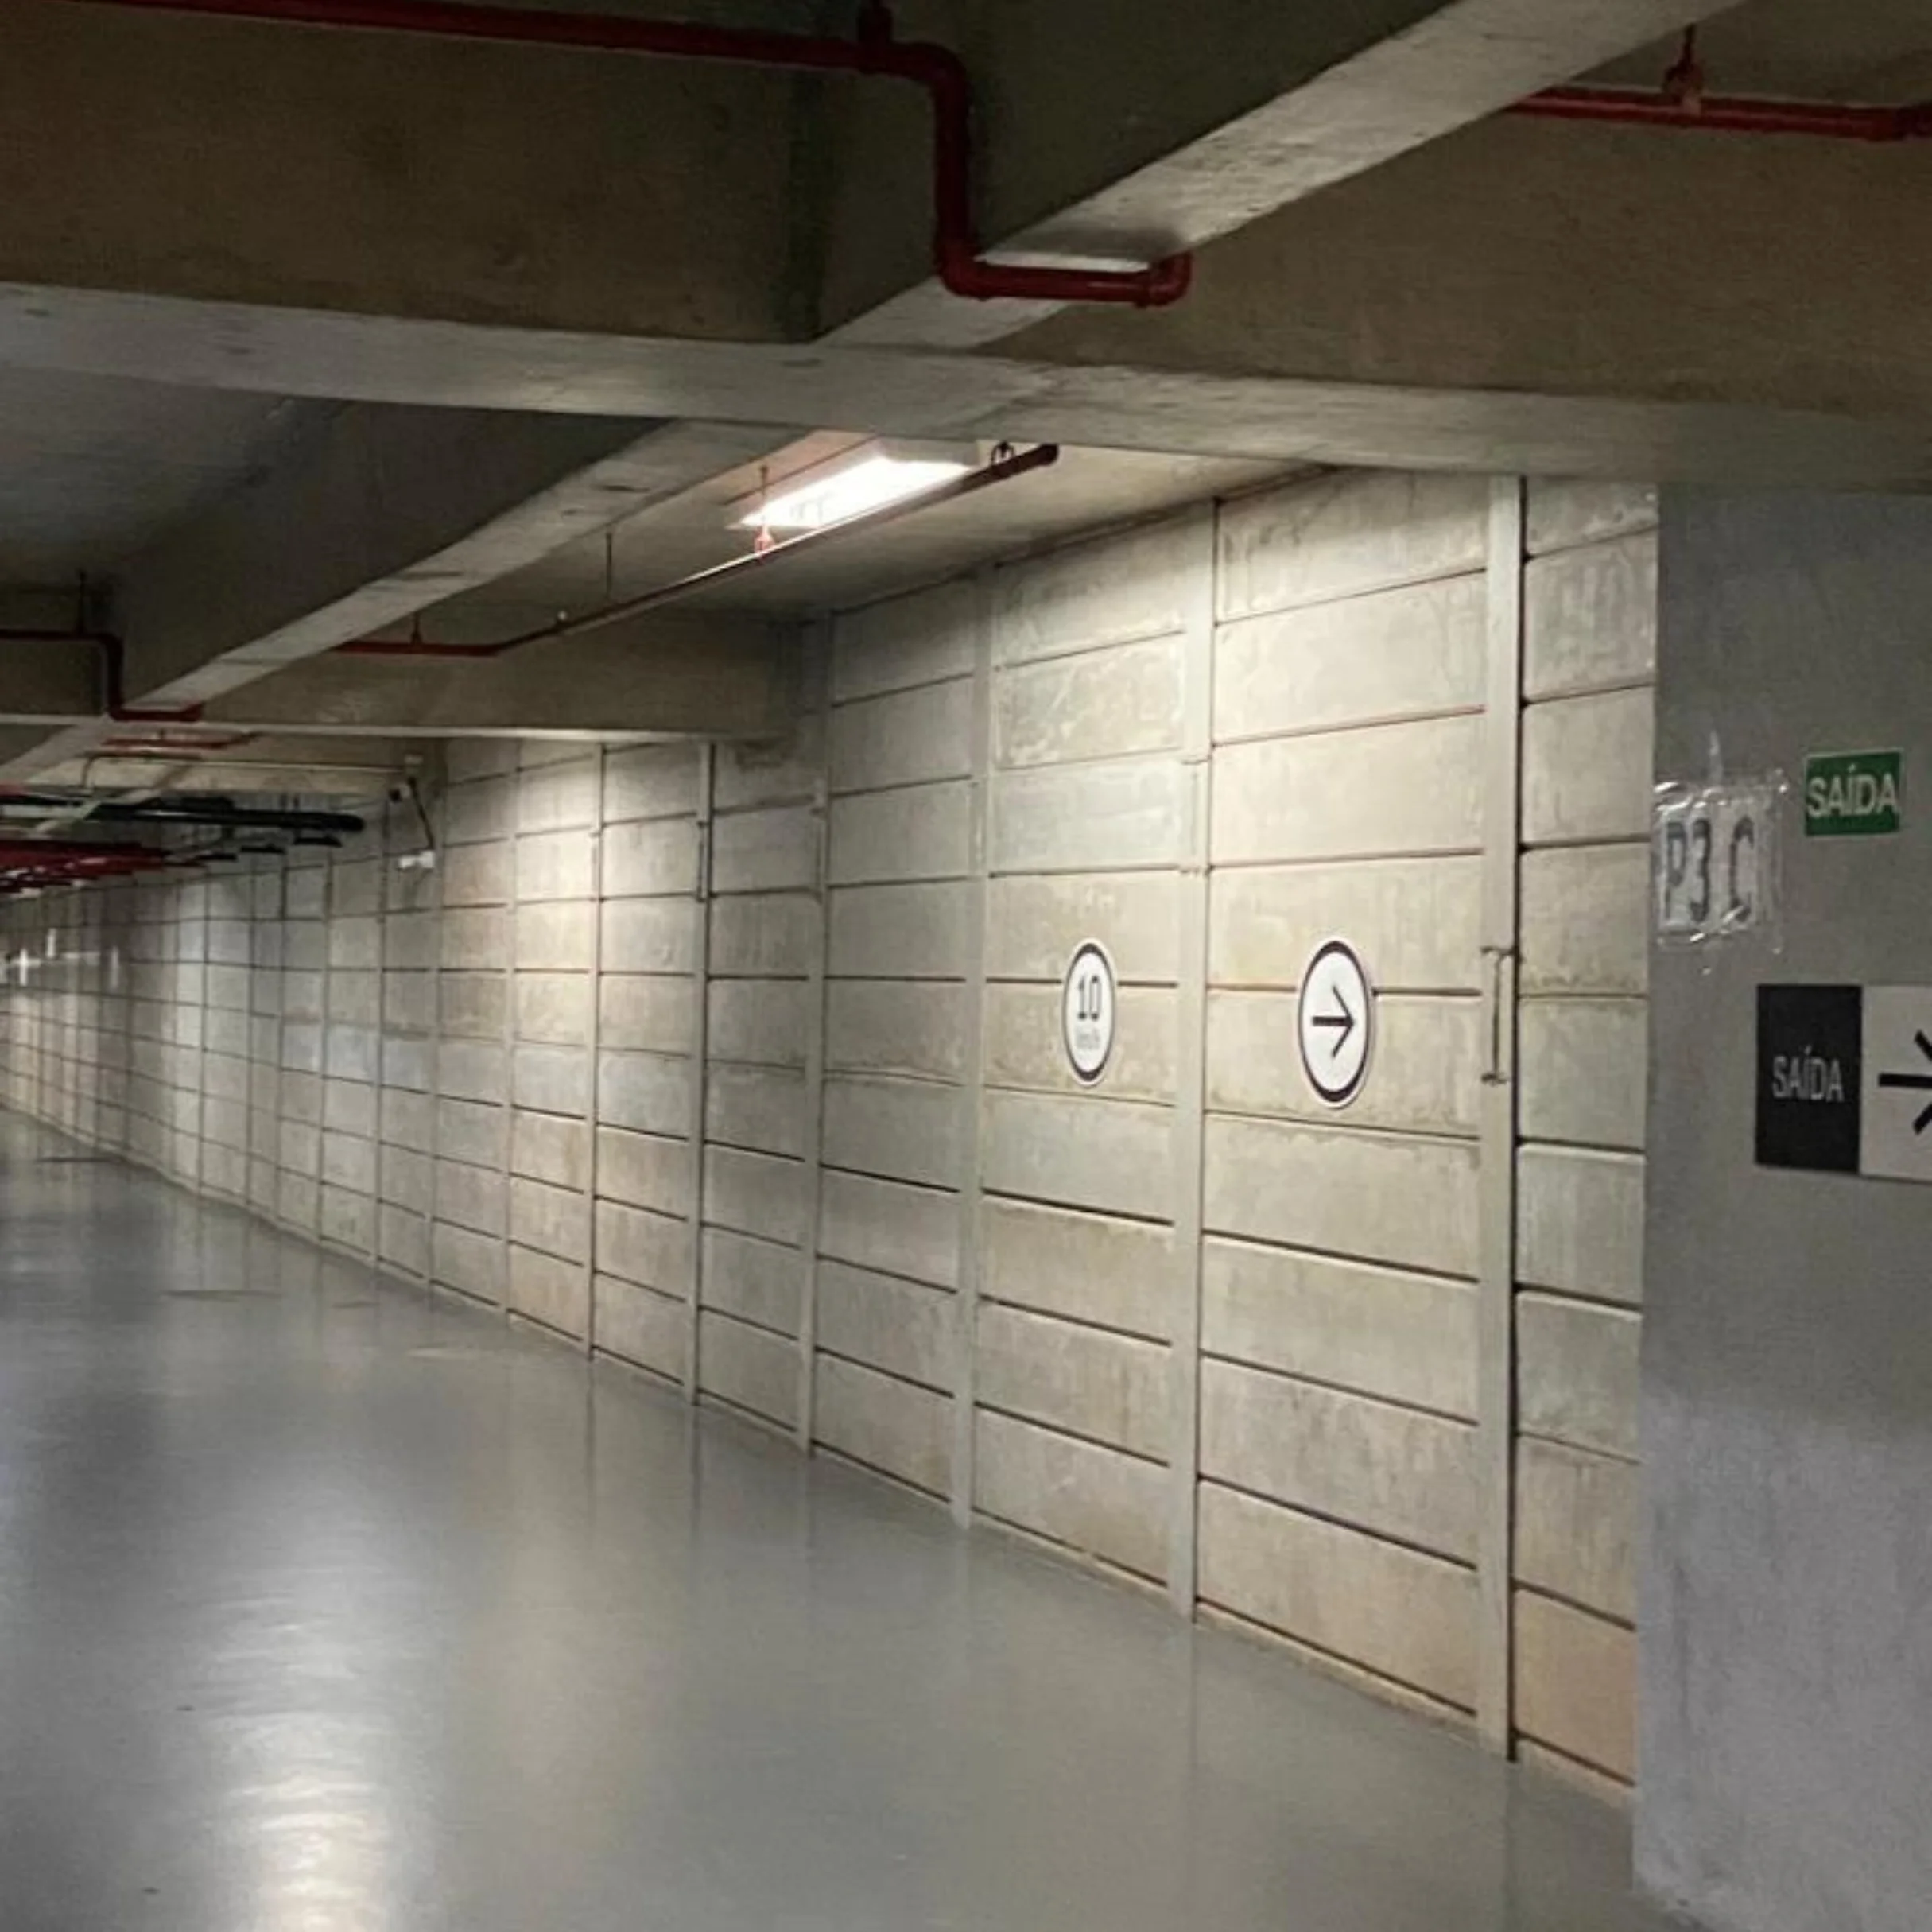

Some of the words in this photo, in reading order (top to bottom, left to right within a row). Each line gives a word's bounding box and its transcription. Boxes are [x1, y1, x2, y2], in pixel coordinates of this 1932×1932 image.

[1808, 763, 1899, 818] SAÍDA
[1078, 975, 1102, 1021] 10
[1772, 1044, 1845, 1102] SAÍDA
